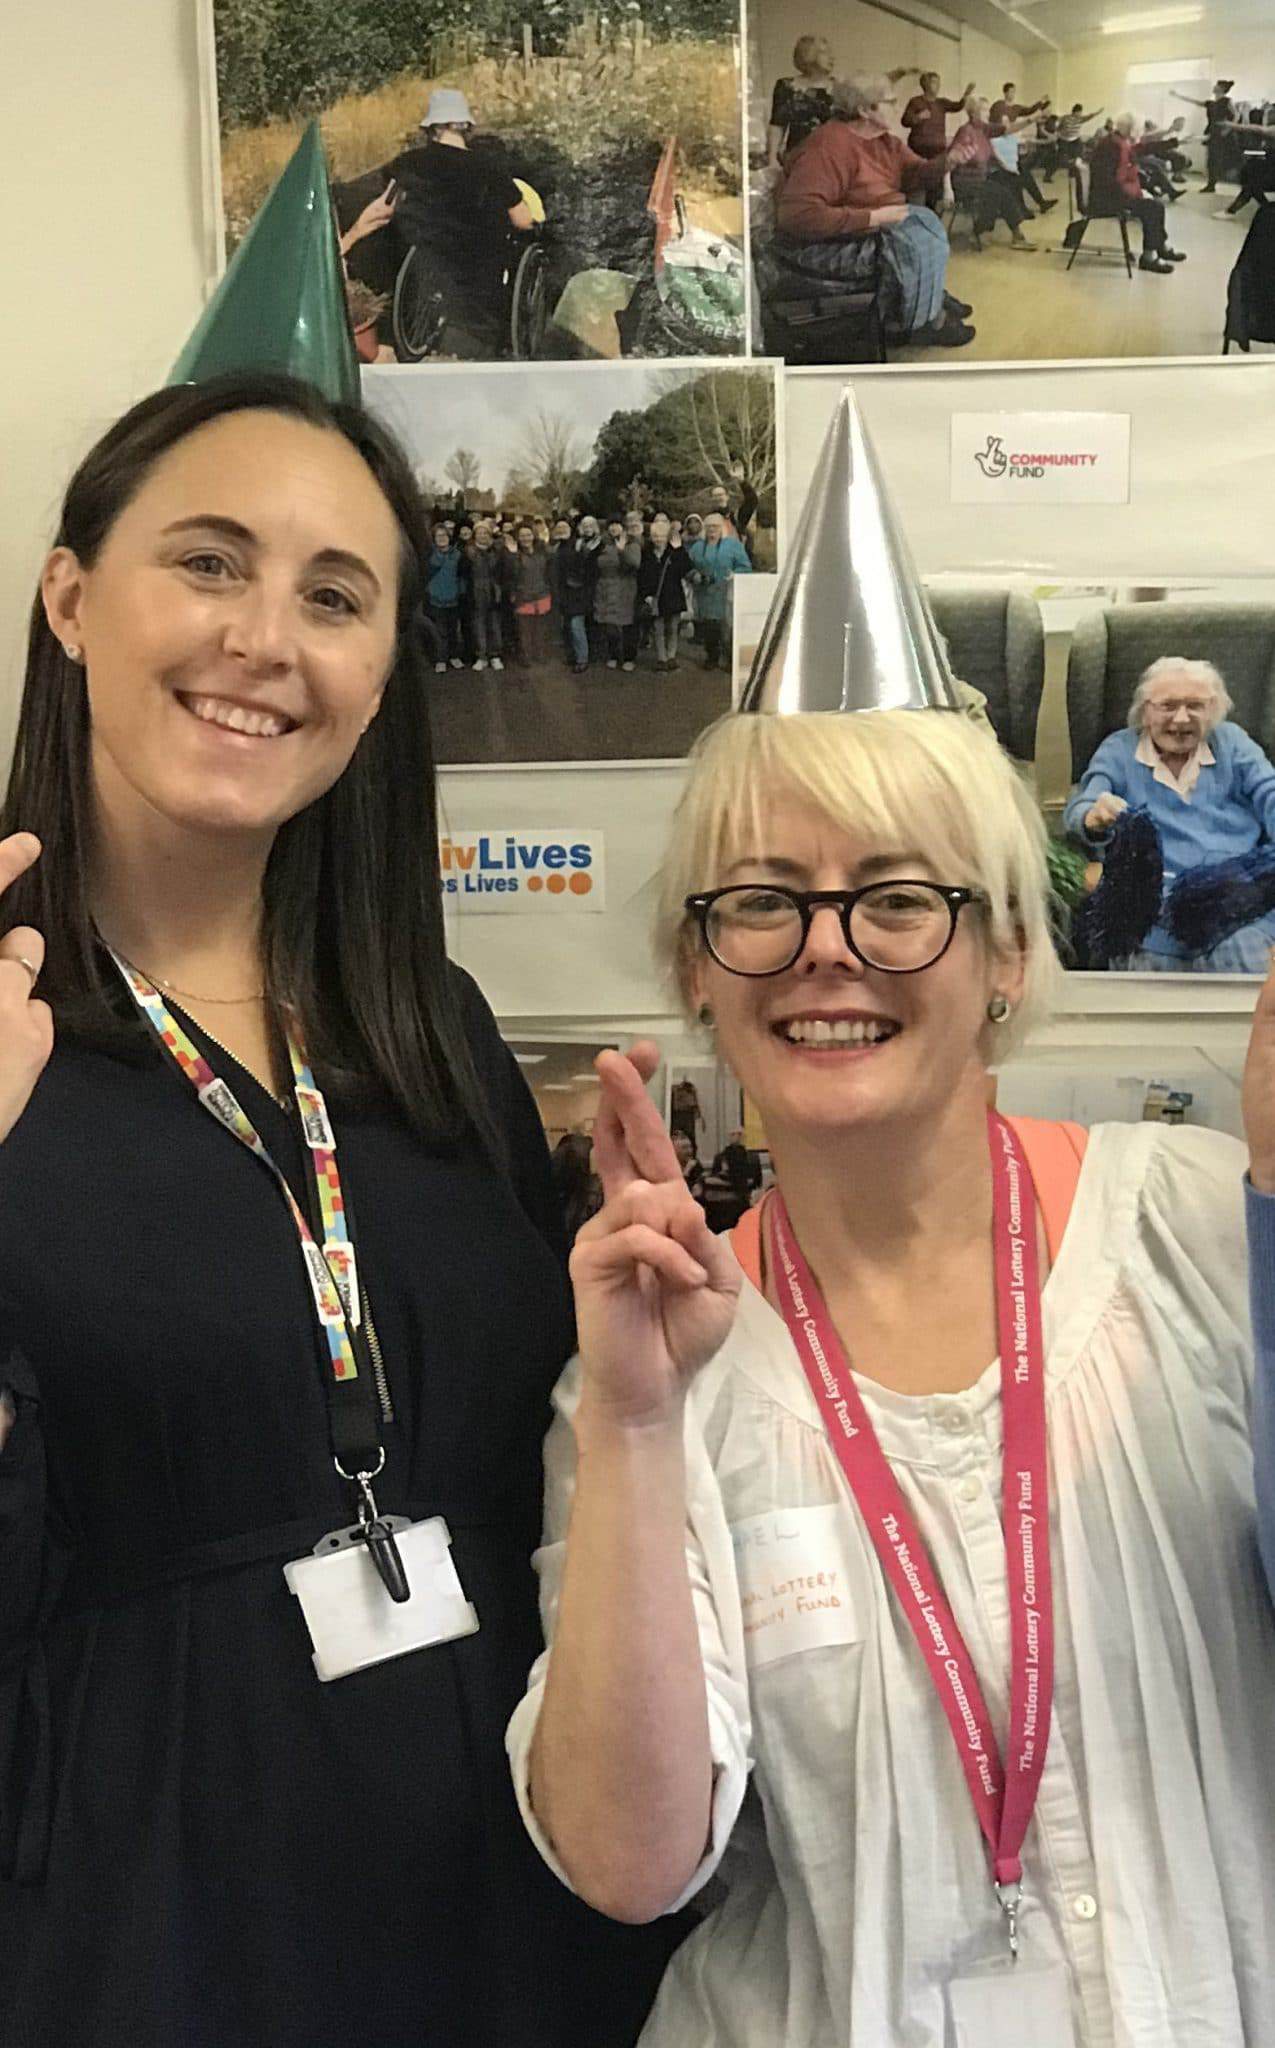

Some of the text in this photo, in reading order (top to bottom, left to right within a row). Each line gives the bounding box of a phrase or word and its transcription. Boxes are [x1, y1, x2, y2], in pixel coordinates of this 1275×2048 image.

[1009, 453, 1099, 466] COMMUNITY
[1009, 466, 1045, 478] FUND
[441, 837, 592, 870] ivLives
[464, 873, 519, 893] Lives
[1005, 1153, 1022, 1235] Community
[1011, 1237, 1026, 1287] Lottery
[1012, 1290, 1028, 1353] National
[787, 1272, 810, 1318] Lottery
[803, 1319, 842, 1400] Community
[834, 1399, 859, 1438] Fund
[1015, 1355, 1029, 1384] The
[771, 1571, 837, 1597] LOTTERY
[1017, 1471, 1040, 1772] The National Lottery Community Fund
[882, 1513, 997, 1797] The National Lottery Community Fund
